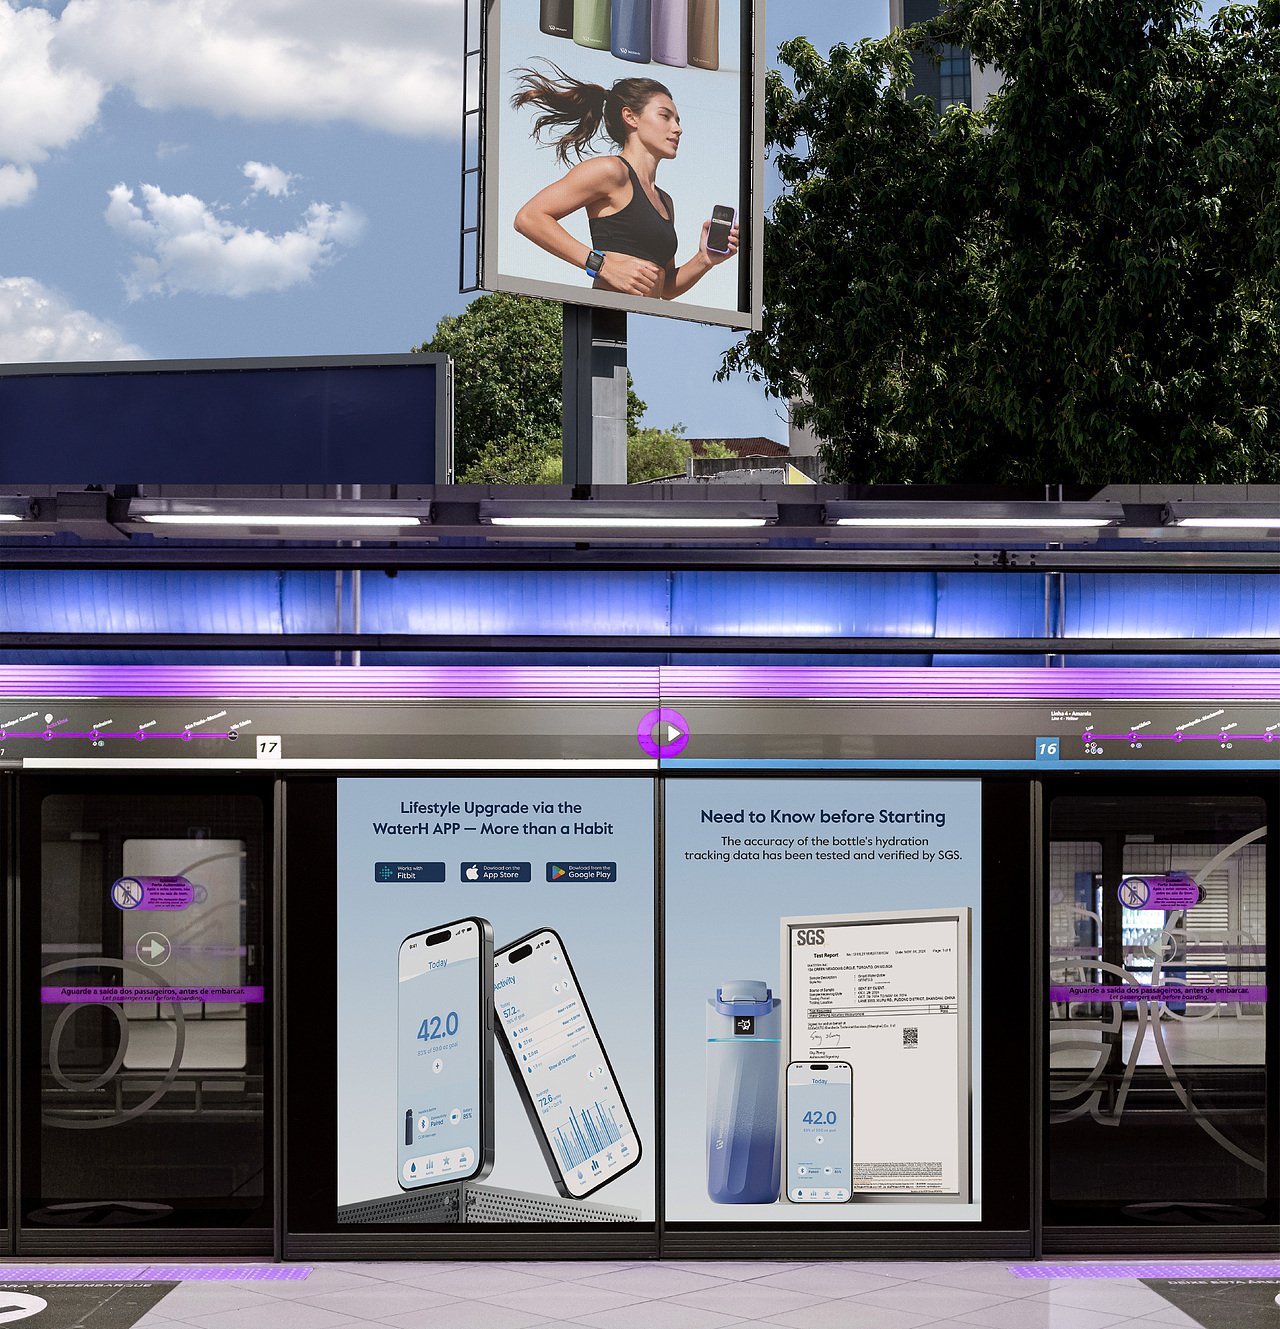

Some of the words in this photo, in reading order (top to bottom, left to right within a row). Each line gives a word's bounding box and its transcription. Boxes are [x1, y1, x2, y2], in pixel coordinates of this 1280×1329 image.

[260, 742, 278, 752] 17
[1039, 743, 1057, 754] 16
[400, 801, 460, 817] Lifestyle
[464, 801, 529, 817] Upgrade
[532, 802, 554, 814] via
[557, 801, 582, 814] the
[701, 810, 744, 823] Need
[749, 812, 766, 823] to
[770, 810, 816, 823] Know
[820, 809, 875, 823] before
[879, 809, 946, 827] Starting
[373, 823, 429, 835] WaterH
[433, 823, 460, 835] APP
[480, 823, 519, 835] More
[522, 822, 556, 835] than
[560, 826, 570, 835] a
[574, 822, 614, 835] Habit
[721, 836, 741, 846] The
[744, 838, 794, 848] accuracy
[797, 836, 809, 846] of
[811, 836, 829, 846] the
[832, 836, 873, 846] bottle's
[876, 836, 929, 848] hydration
[685, 851, 730, 862] tracking
[733, 851, 760, 860] data
[763, 851, 782, 860] has
[785, 851, 813, 860] been
[815, 851, 850, 860] tested
[853, 851, 875, 860] and
[878, 850, 919, 860] verified
[922, 851, 936, 862] by
[938, 851, 963, 860] SGS.
[797, 929, 825, 946] SGS
[428, 959, 448, 969] Today
[494, 976, 516, 991] Activity
[61, 988, 91, 996] Aguarde
[134, 988, 177, 996] passageiros,
[417, 1012, 458, 1041] 42.0
[538, 1094, 553, 1107] 72.6
[802, 1111, 836, 1124] 42.0
